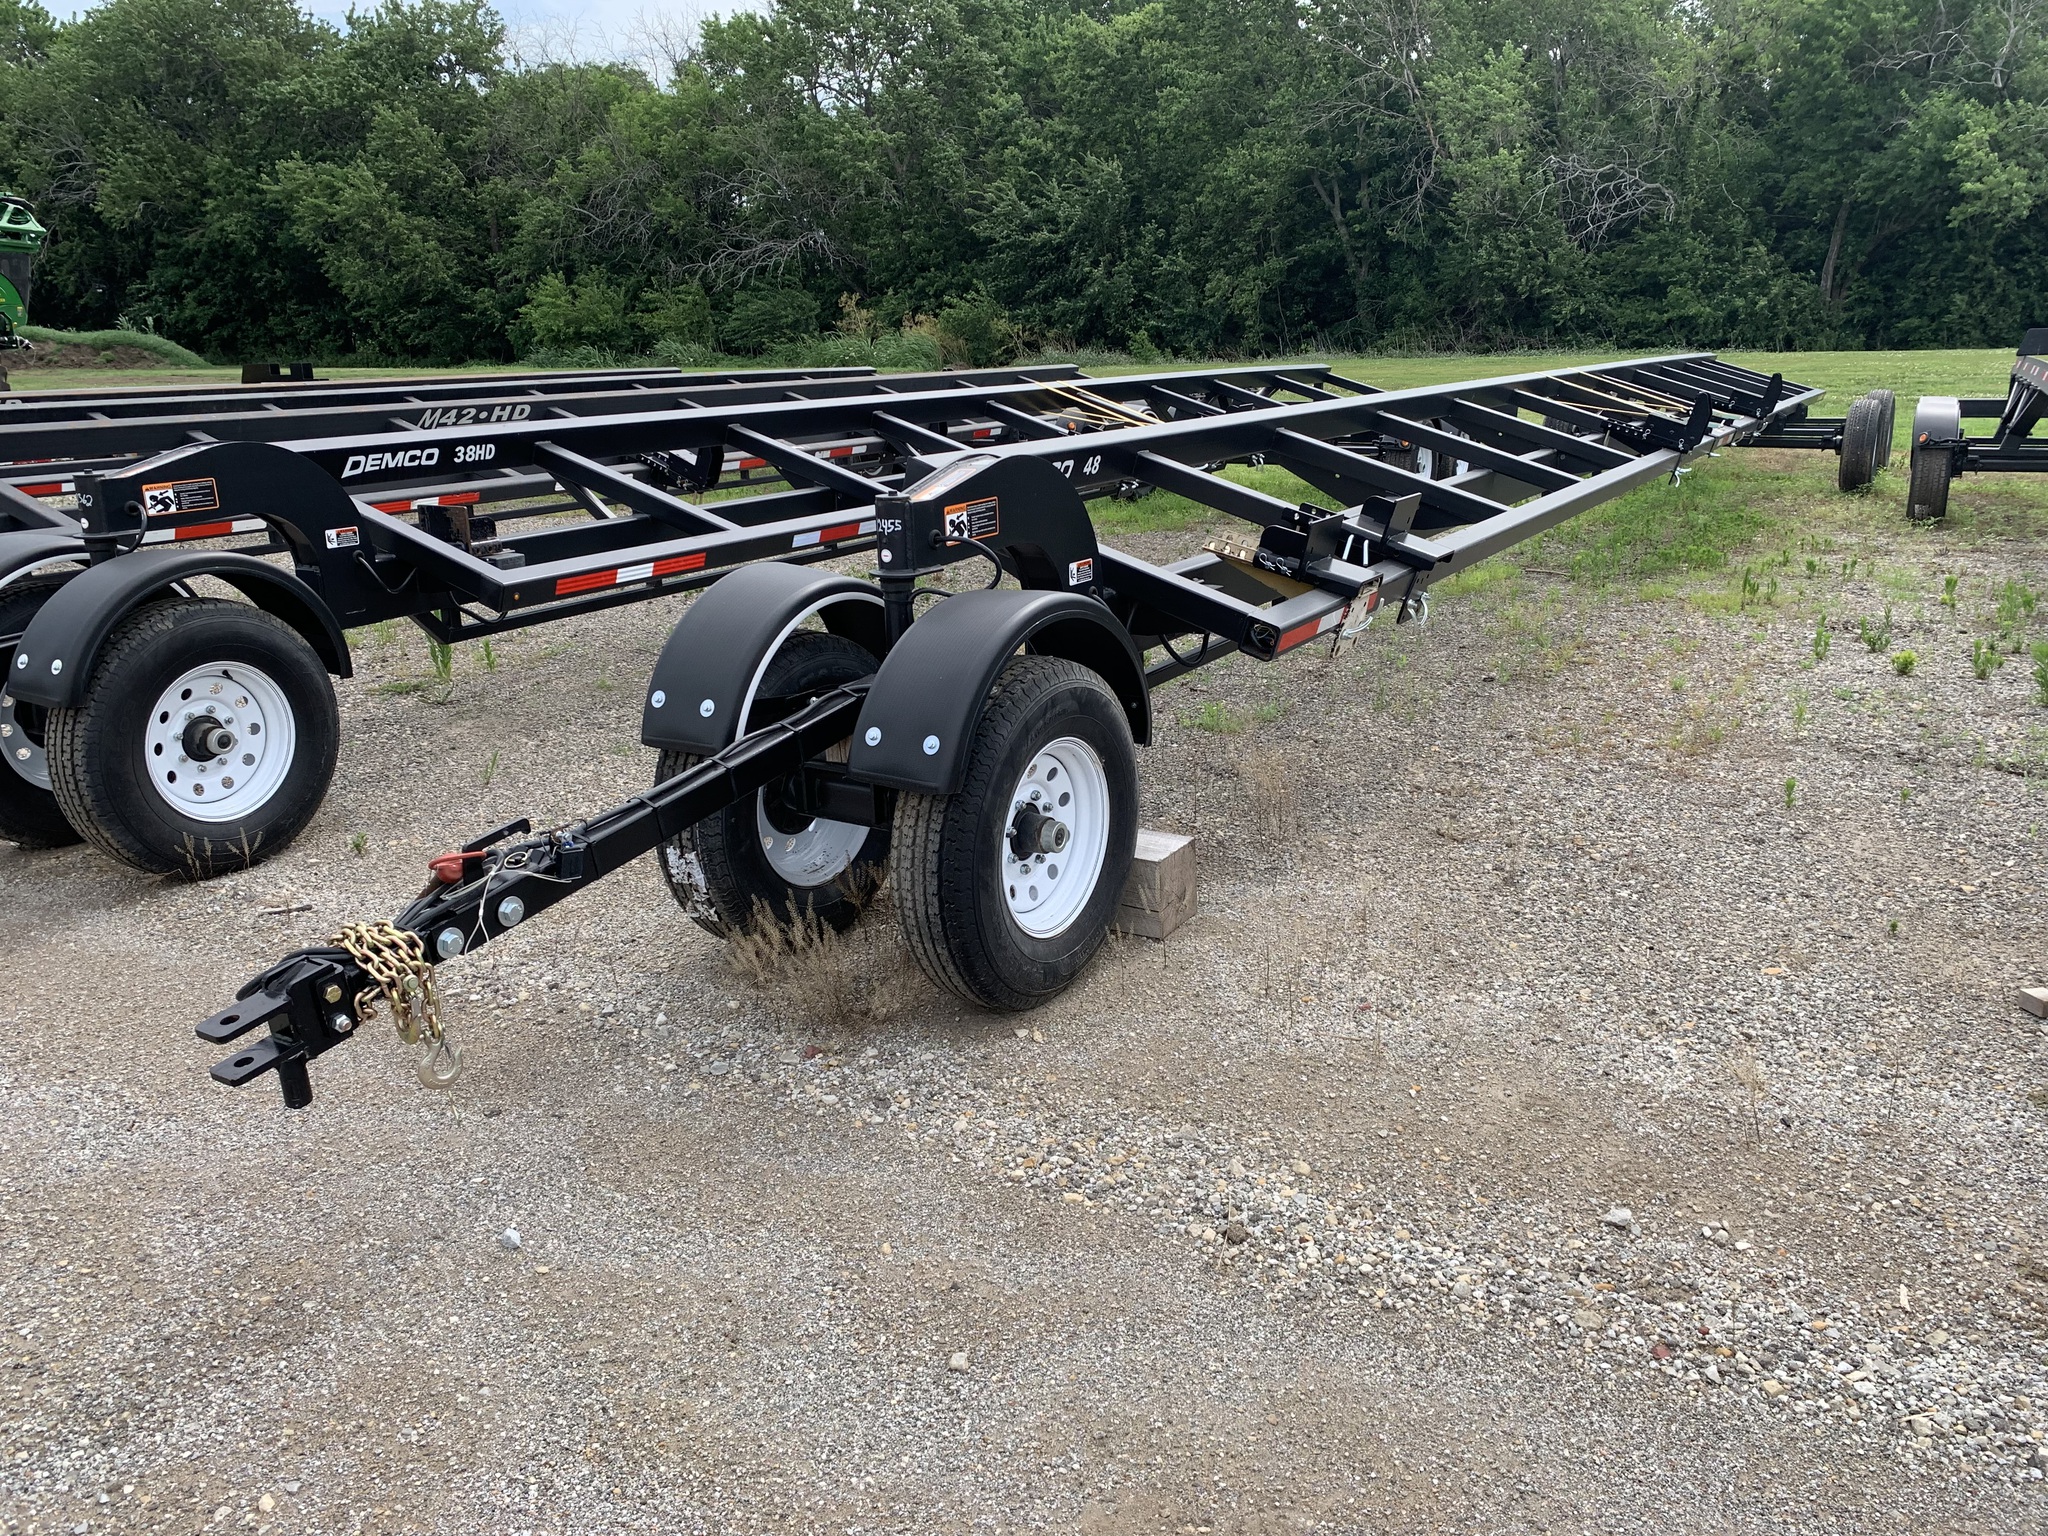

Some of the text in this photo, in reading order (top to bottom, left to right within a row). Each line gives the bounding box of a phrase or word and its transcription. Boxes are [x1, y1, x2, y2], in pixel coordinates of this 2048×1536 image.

[341, 443, 496, 479] DEMCO 38HD
[1083, 454, 1101, 475] 48
[877, 518, 902, 536] 2455
